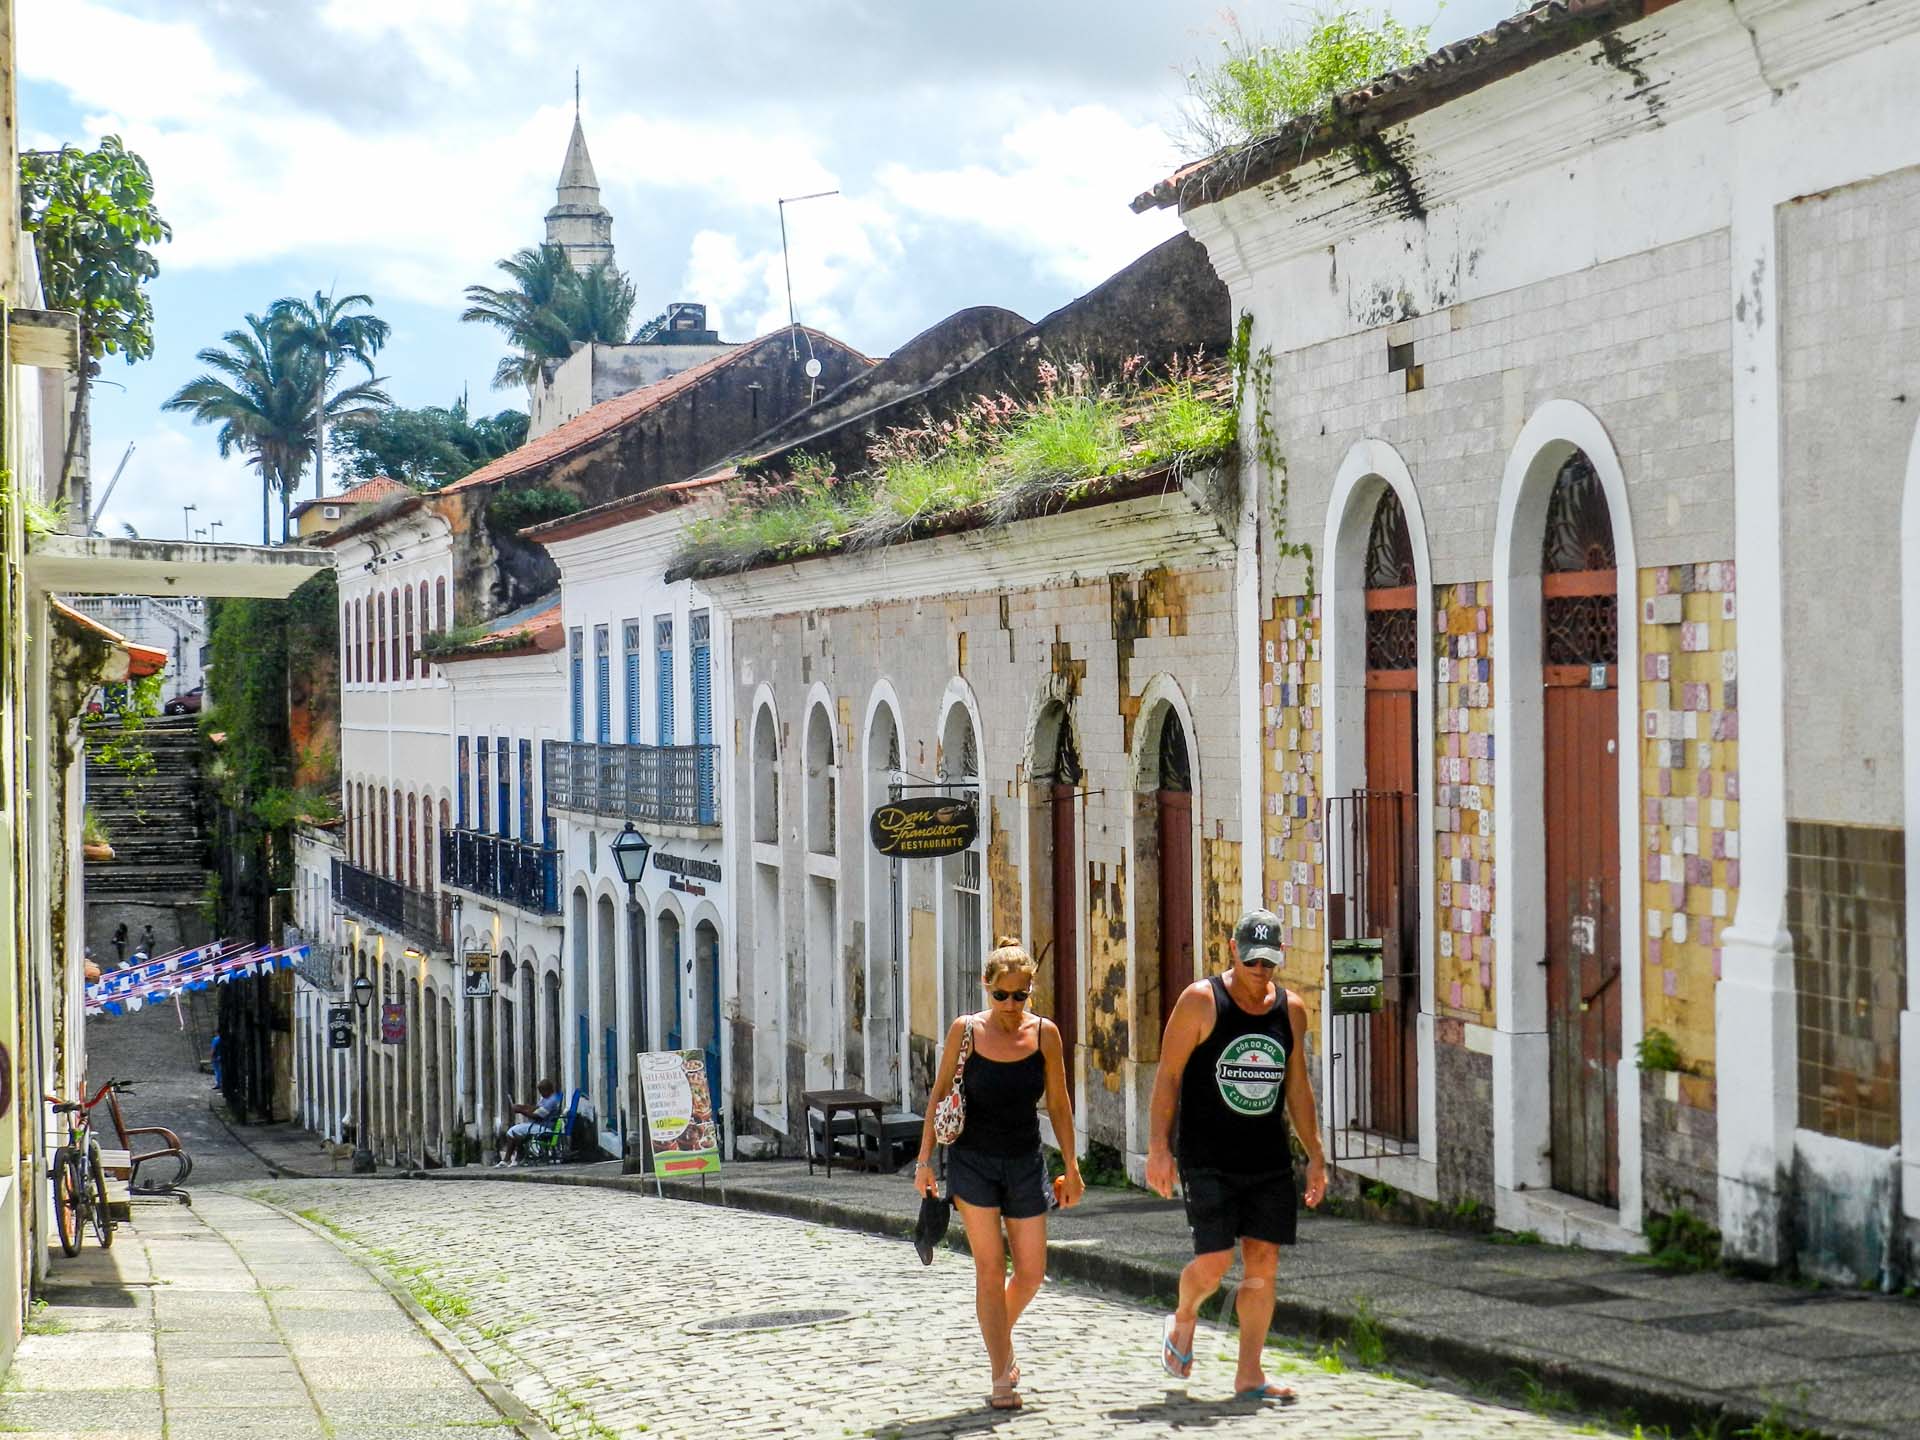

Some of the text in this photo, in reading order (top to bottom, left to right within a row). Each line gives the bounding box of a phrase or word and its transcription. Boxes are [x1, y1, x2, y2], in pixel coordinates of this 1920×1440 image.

[878, 808, 934, 830] Dom
[880, 823, 968, 851] Francisco
[901, 838, 963, 850] RESTAURANTE
